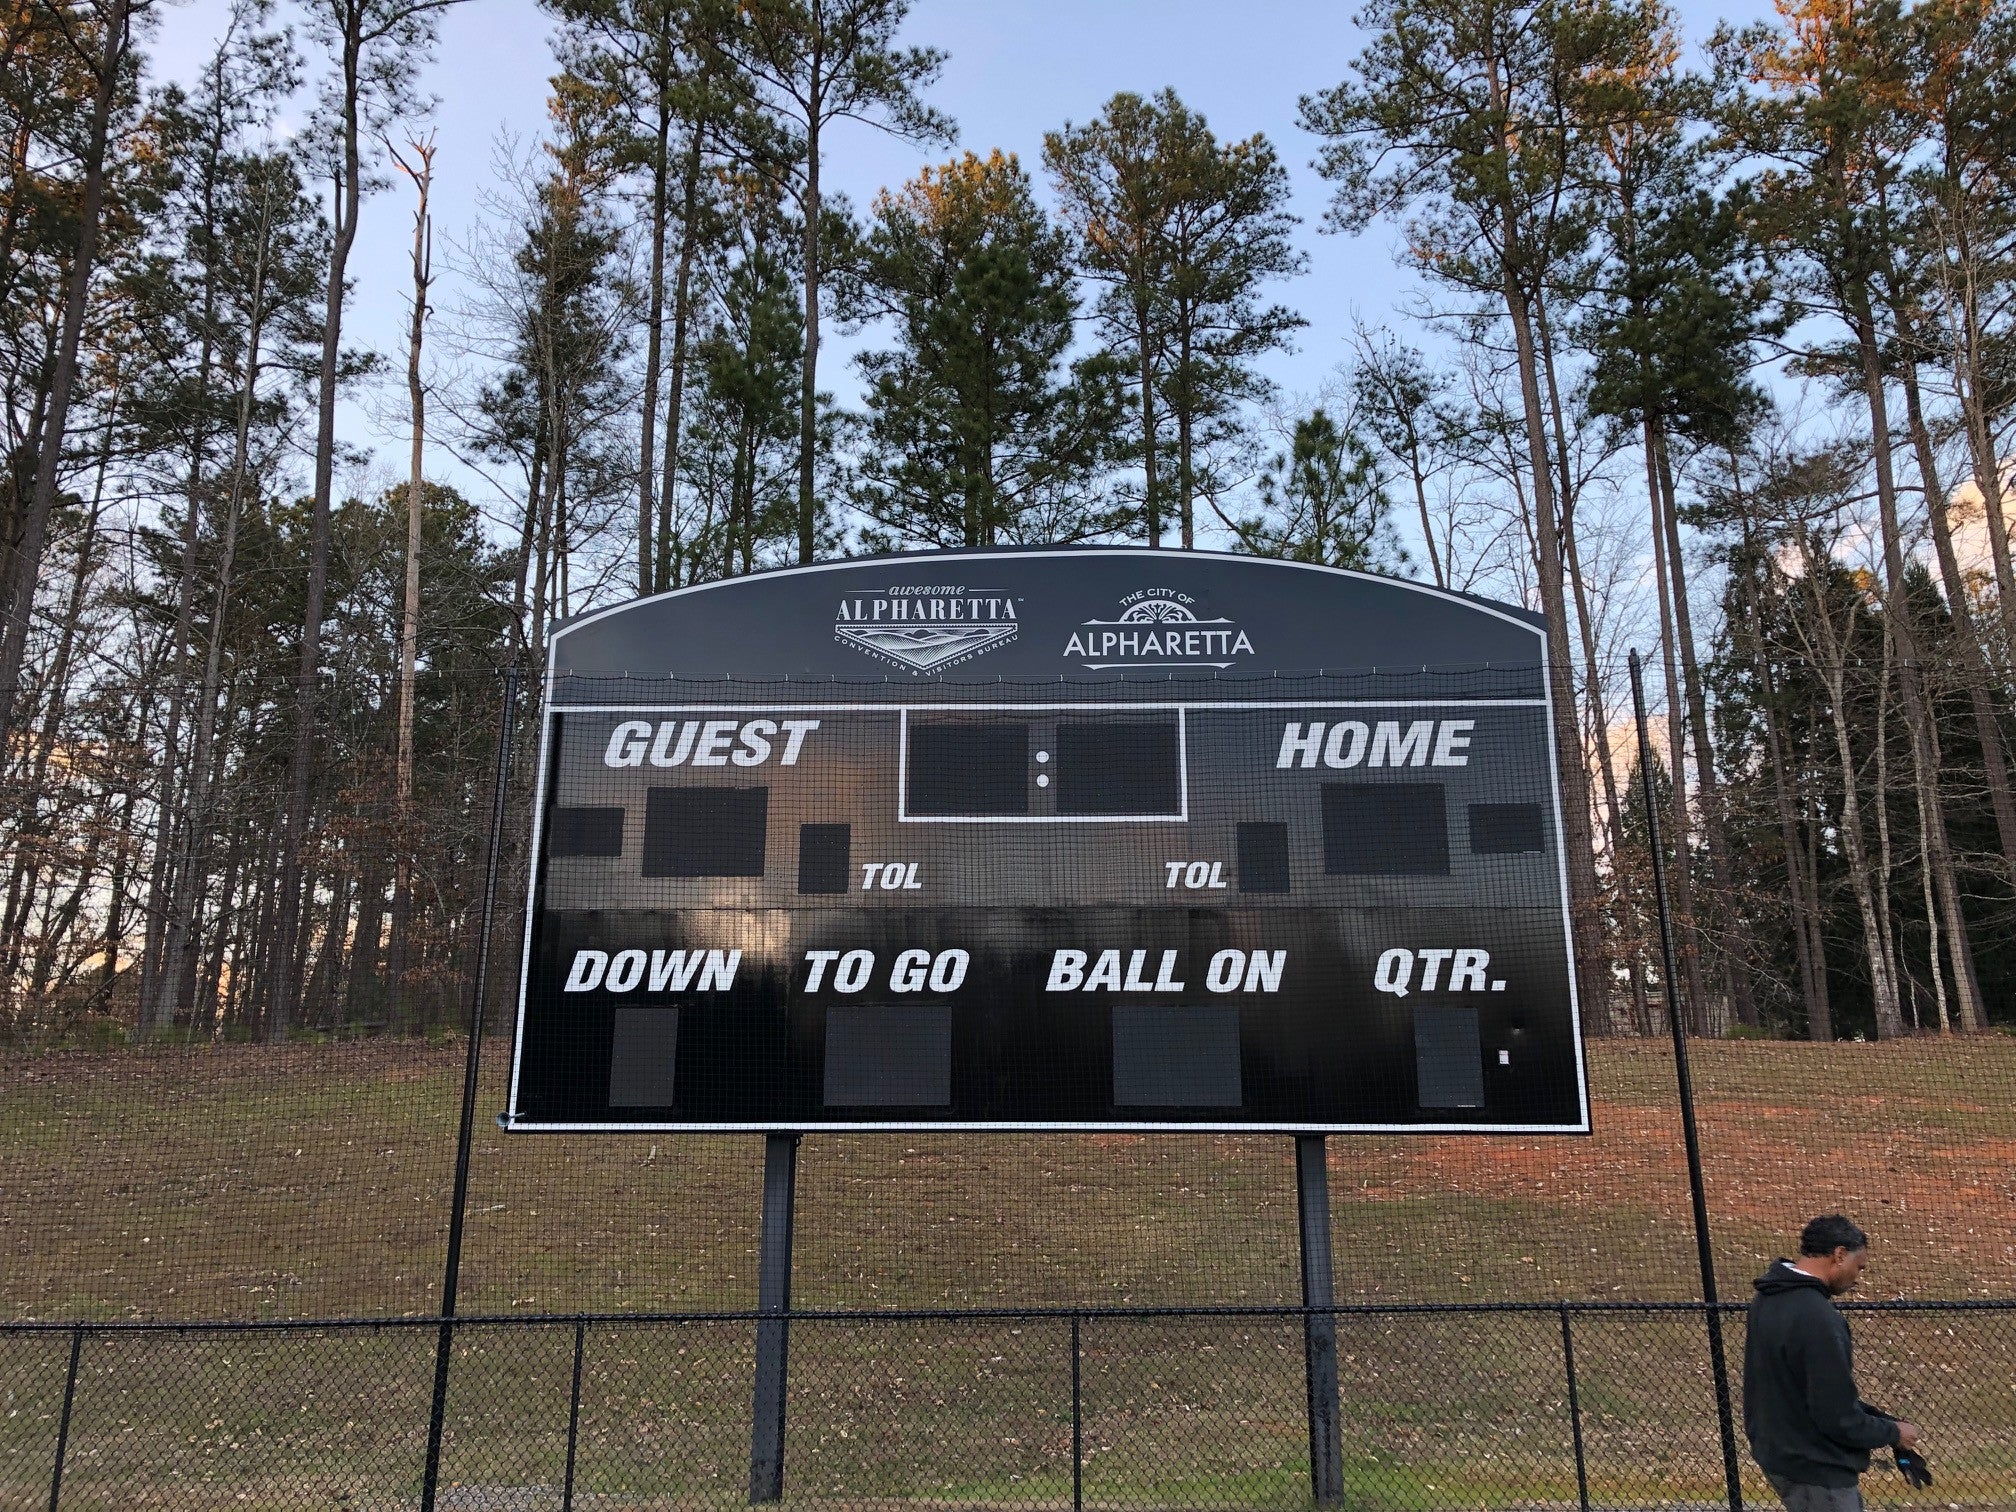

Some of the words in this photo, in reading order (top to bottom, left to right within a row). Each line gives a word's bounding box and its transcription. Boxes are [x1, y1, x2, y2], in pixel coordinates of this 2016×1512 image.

[836, 598, 1017, 621] ALPHARETTA
[888, 585, 966, 596] awesome
[1119, 590, 1145, 606] THE
[1147, 588, 1176, 597] CITY
[1177, 593, 1196, 604] OF
[834, 635, 907, 671] CONVENTION
[925, 653, 973, 677] VISITORS
[977, 634, 1019, 655] BUREAU
[1063, 629, 1256, 657] ALPHARETTA
[604, 719, 821, 768] GUEST
[1276, 719, 1475, 768] HOME
[861, 862, 922, 890] TOL
[1165, 861, 1227, 889] TOL
[563, 949, 742, 992] DOWN
[804, 949, 875, 993] TO
[889, 948, 970, 993] GO
[1045, 949, 1185, 992] BALL
[1205, 949, 1287, 993] ON
[1374, 948, 1507, 998] QTR.
